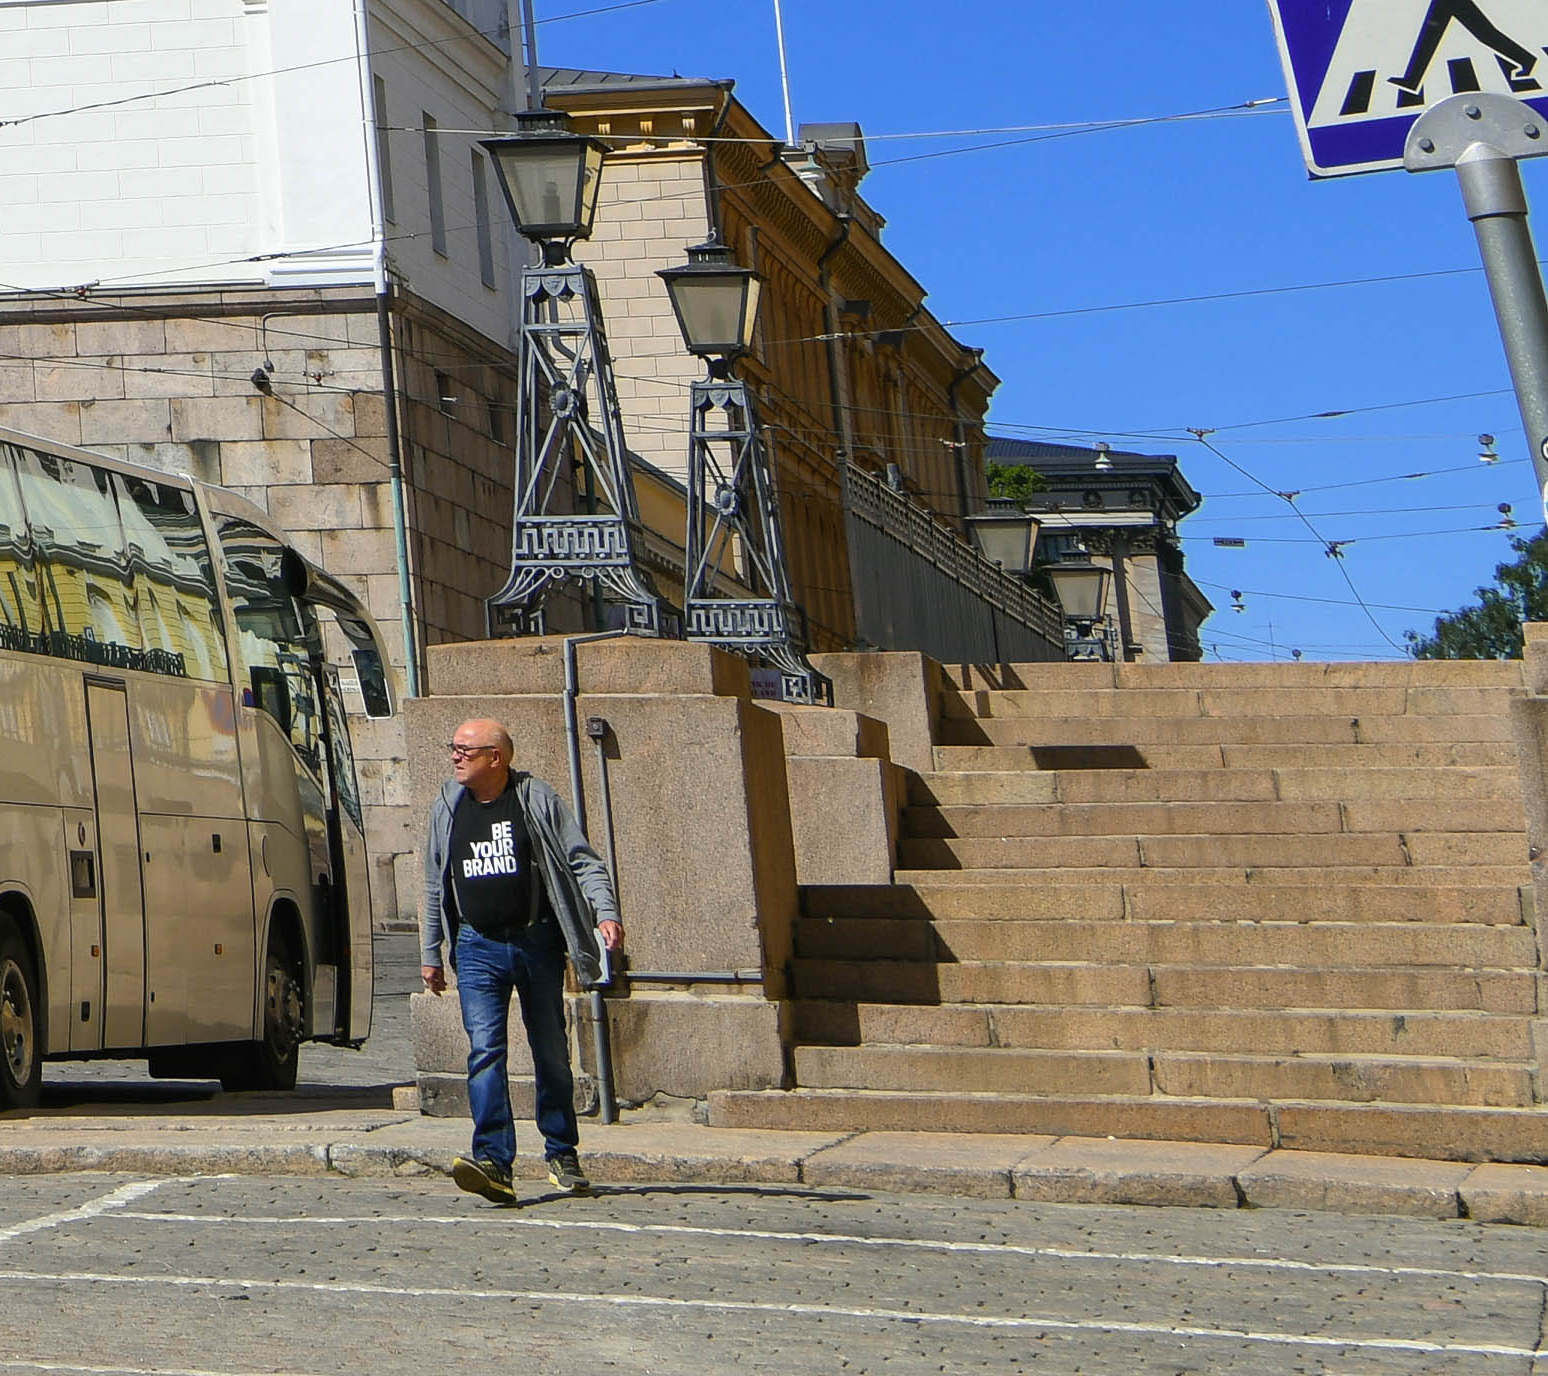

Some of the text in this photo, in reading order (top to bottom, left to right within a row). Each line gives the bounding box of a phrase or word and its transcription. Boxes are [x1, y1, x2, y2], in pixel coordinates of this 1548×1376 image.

[491, 820, 512, 840] BE
[469, 837, 515, 859] YOUR
[462, 855, 517, 879] BRAND
